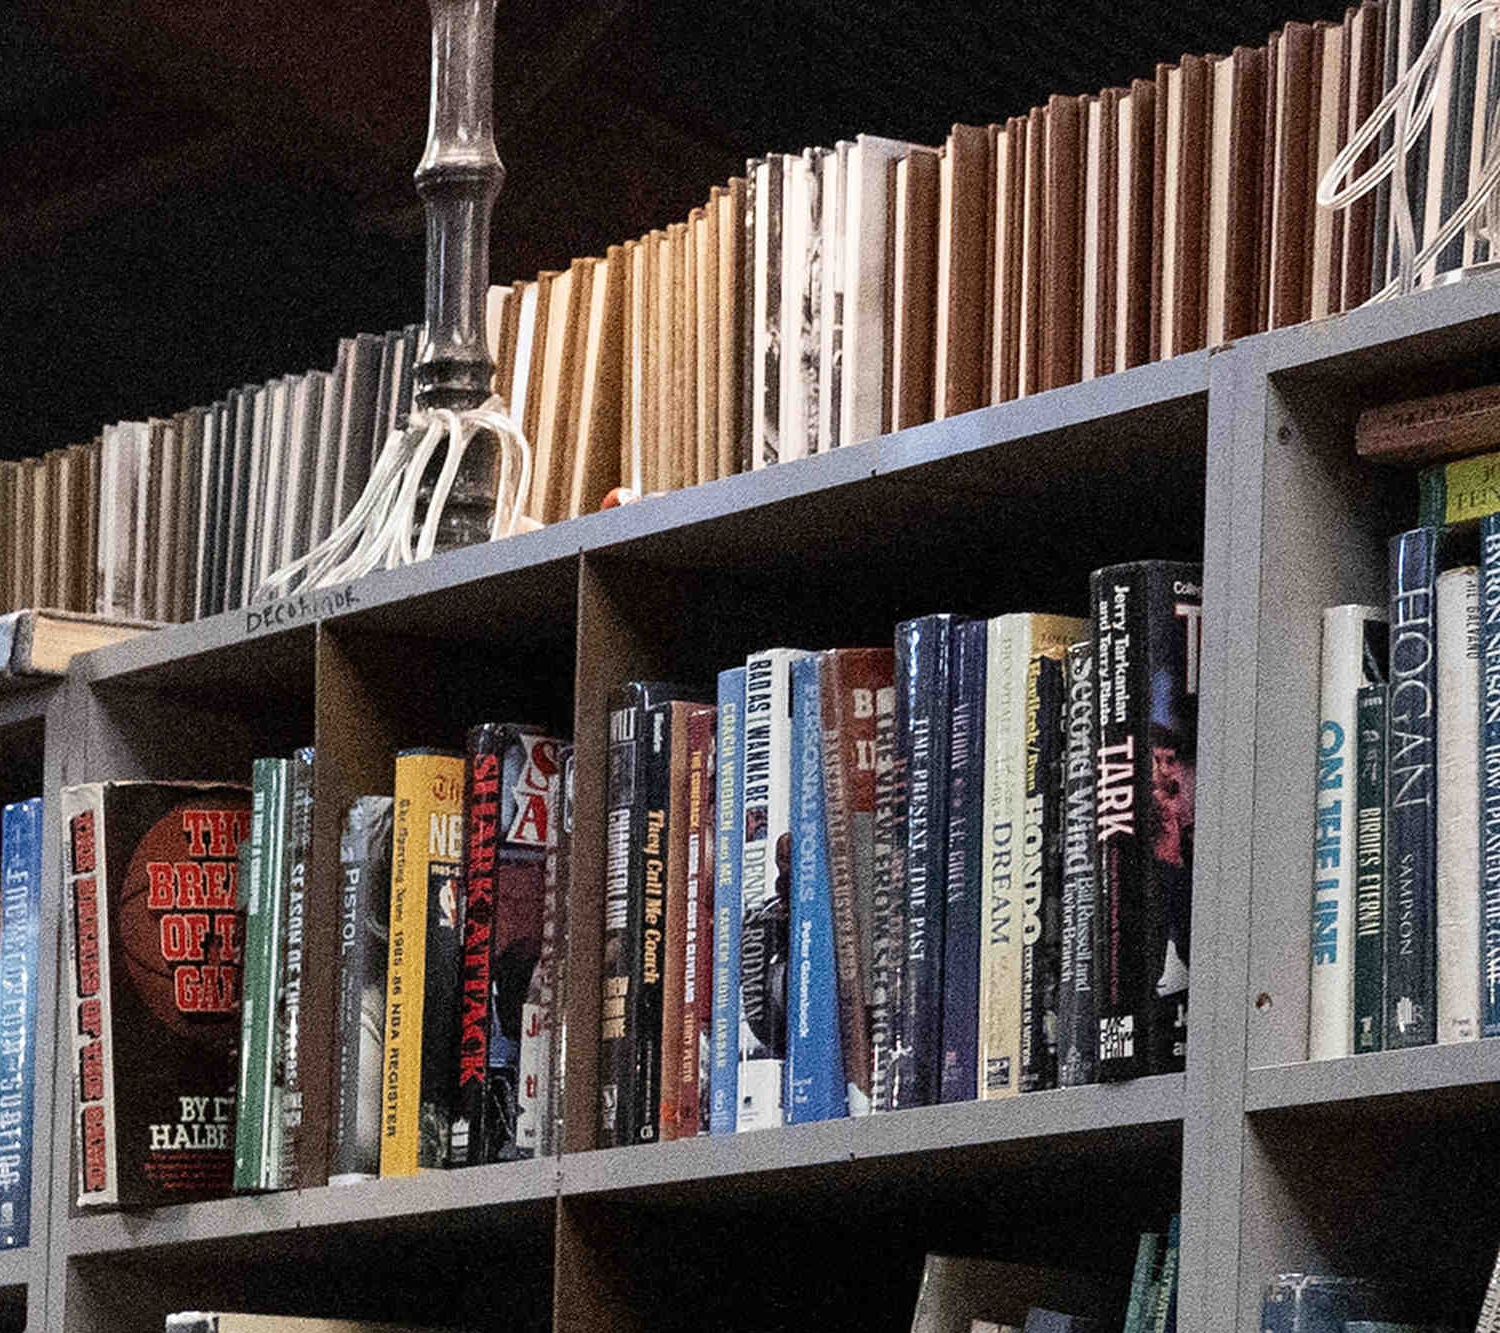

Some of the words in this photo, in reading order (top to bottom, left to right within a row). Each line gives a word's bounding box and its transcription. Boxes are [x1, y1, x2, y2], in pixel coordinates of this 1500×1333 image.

[913, 716, 930, 762] TIME
[1070, 657, 1094, 779] Second
[1392, 587, 1433, 808] HOGAN
[800, 683, 821, 818] PERSONAL
[1097, 736, 1134, 841] TARK
[1320, 721, 1344, 789] ON
[467, 754, 498, 912] SHARK
[643, 809, 666, 854] They
[799, 829, 817, 904] FOULS
[1022, 794, 1043, 946] HONDO
[1066, 785, 1095, 873] Wind
[1318, 799, 1341, 869] THE
[341, 867, 360, 955] PISTOL
[645, 859, 663, 895] Call
[645, 897, 662, 925] Me
[911, 863, 927, 909] TIME
[991, 821, 1013, 945] DREAM
[1399, 853, 1414, 954] SAMPSON
[161, 914, 212, 961] OF
[642, 928, 661, 985] Coach
[909, 915, 925, 962] PAST
[1313, 878, 1339, 964] LINE
[460, 919, 491, 1087] ATTACK
[742, 922, 765, 1022] RODMAN
[180, 1097, 207, 1124] BY
[386, 1046, 401, 1138] REGISTER
